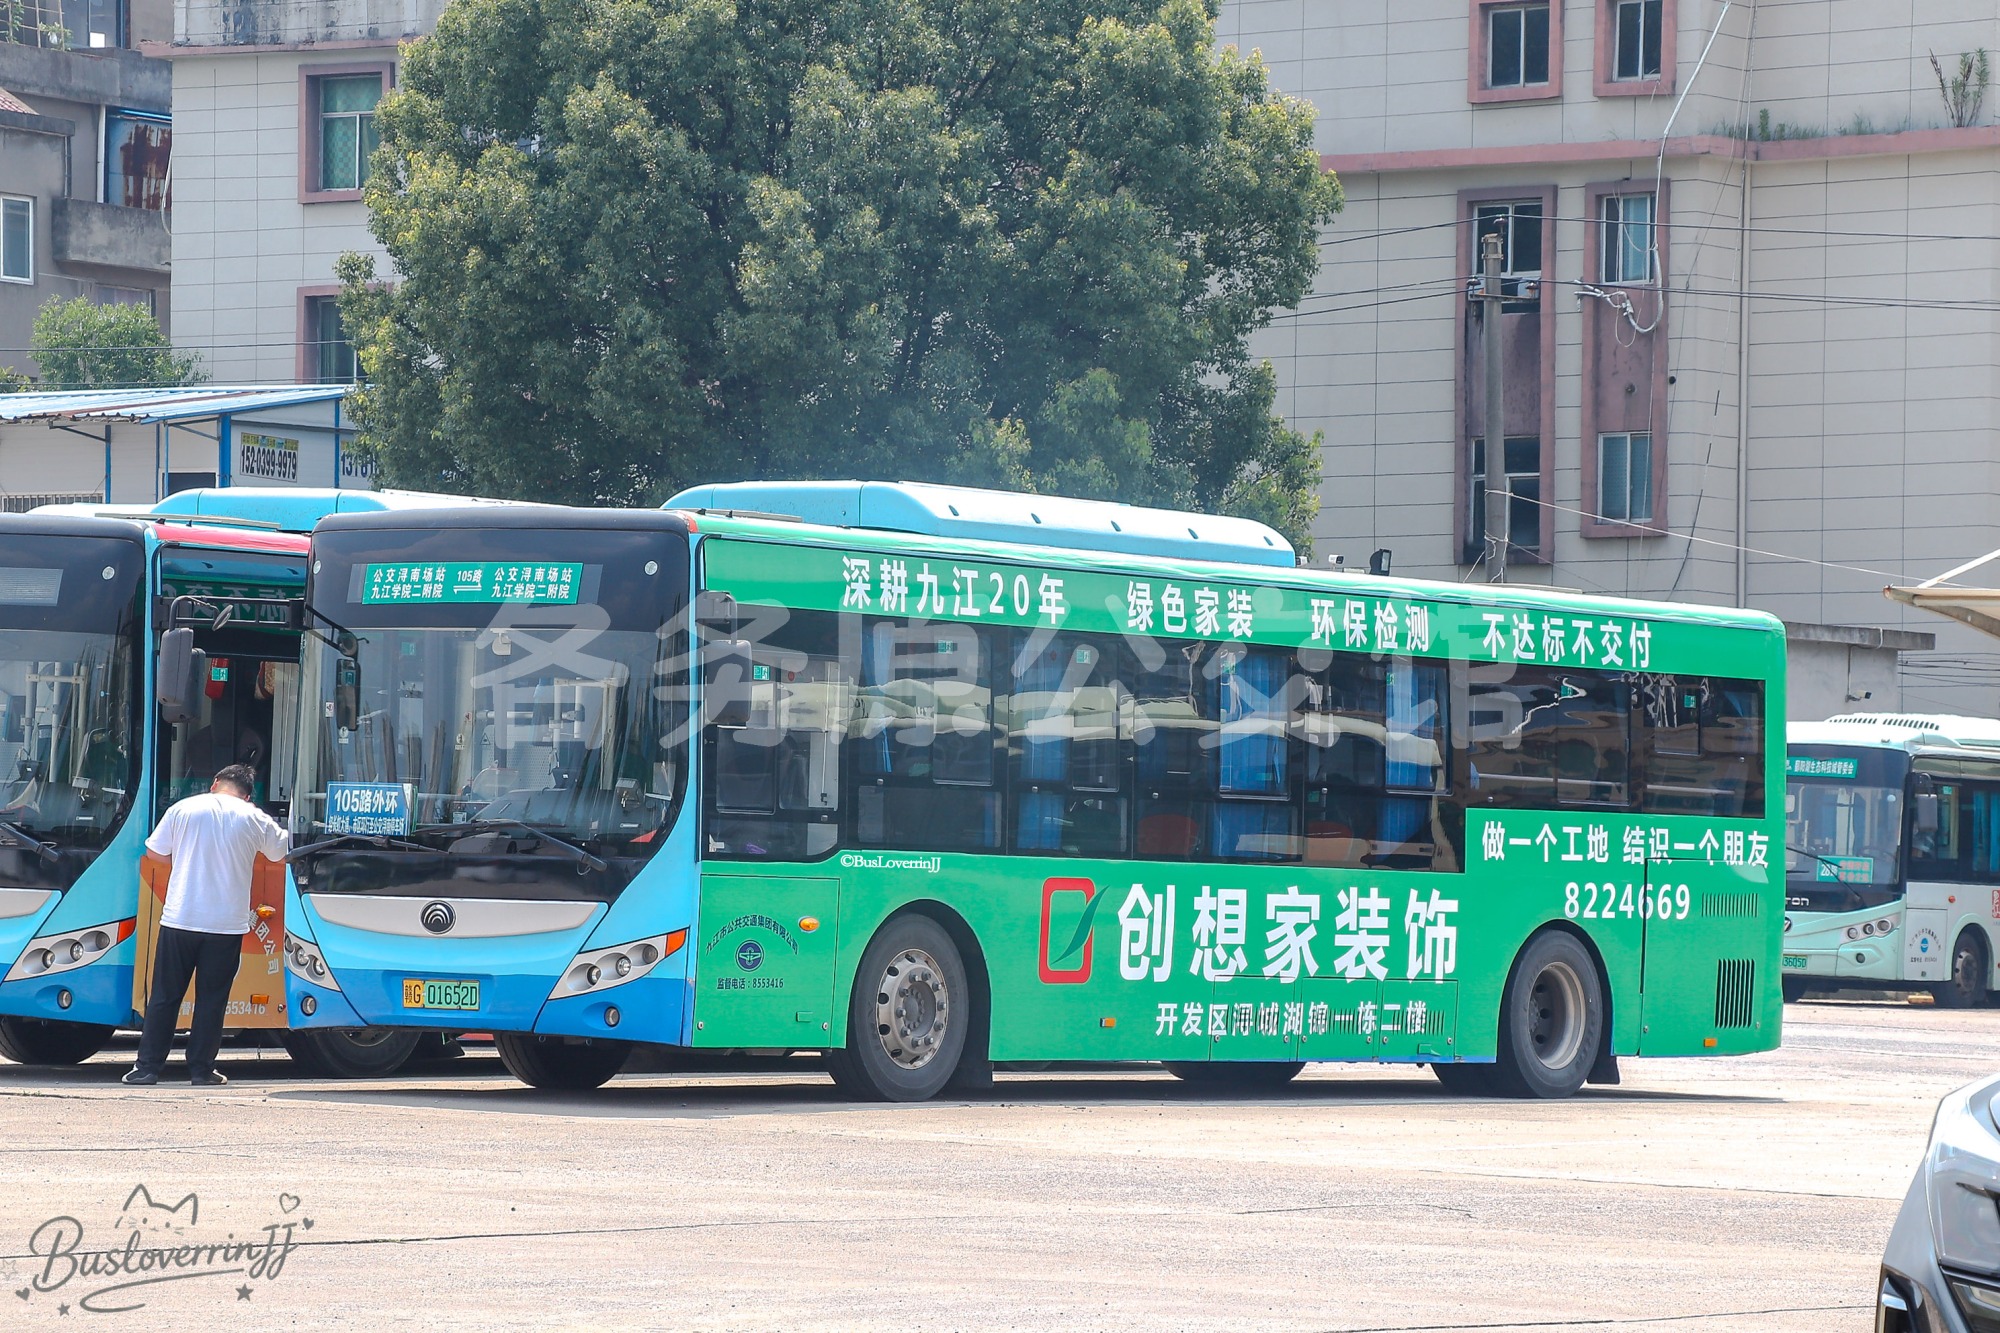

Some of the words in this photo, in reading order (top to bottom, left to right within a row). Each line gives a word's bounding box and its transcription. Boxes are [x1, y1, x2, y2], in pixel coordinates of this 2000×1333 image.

[241, 445, 298, 480] 152-0399-9979
[371, 583, 443, 599] 九江学院二附院
[491, 583, 570, 599] 九江学院二附院
[373, 567, 447, 583] 公交浔南场站
[457, 570, 483, 583] 105路
[494, 567, 573, 583] 公交浔南场站
[842, 555, 1066, 625] 深耕九江20年
[1127, 580, 1253, 639] 绿色家装
[1311, 598, 1430, 653] 环保检测
[1482, 612, 1653, 669] 不达标不交付
[334, 789, 399, 814] 105路外环
[1482, 820, 1609, 863] 做一个工地
[1622, 824, 1770, 868] 结识一个朋友
[1564, 881, 1691, 920] 8224669
[1117, 883, 1460, 984] 创想家装饰
